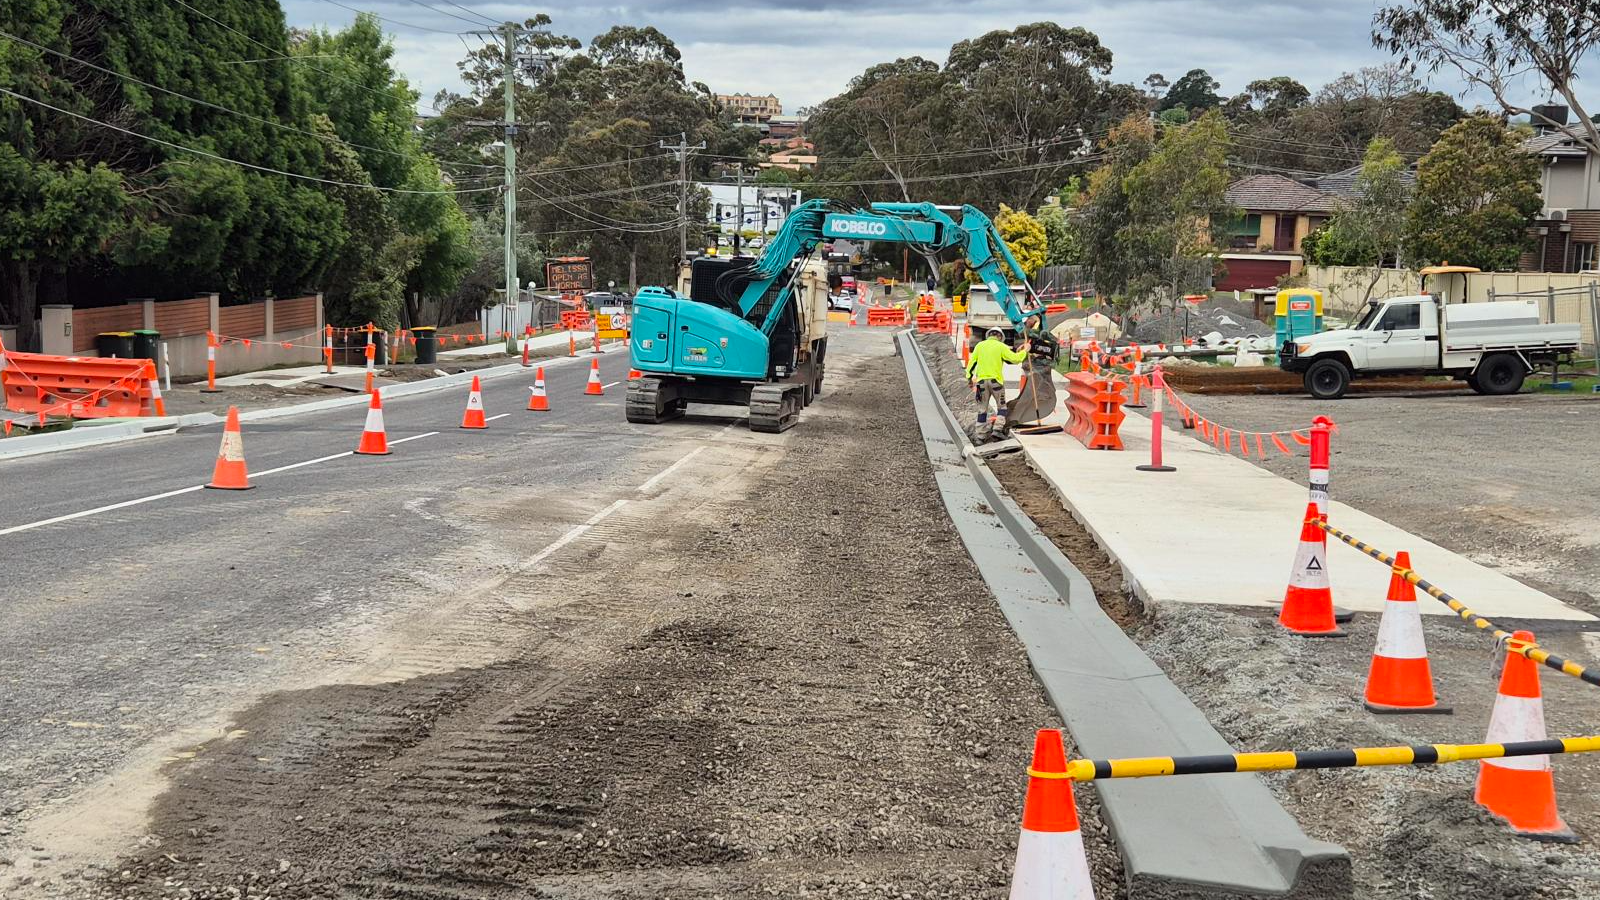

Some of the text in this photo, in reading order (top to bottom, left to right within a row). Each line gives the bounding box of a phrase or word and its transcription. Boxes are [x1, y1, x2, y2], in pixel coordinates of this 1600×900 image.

[831, 219, 886, 235] KOBELCO
[551, 264, 588, 274] MELISSA
[552, 273, 573, 282] OPEN
